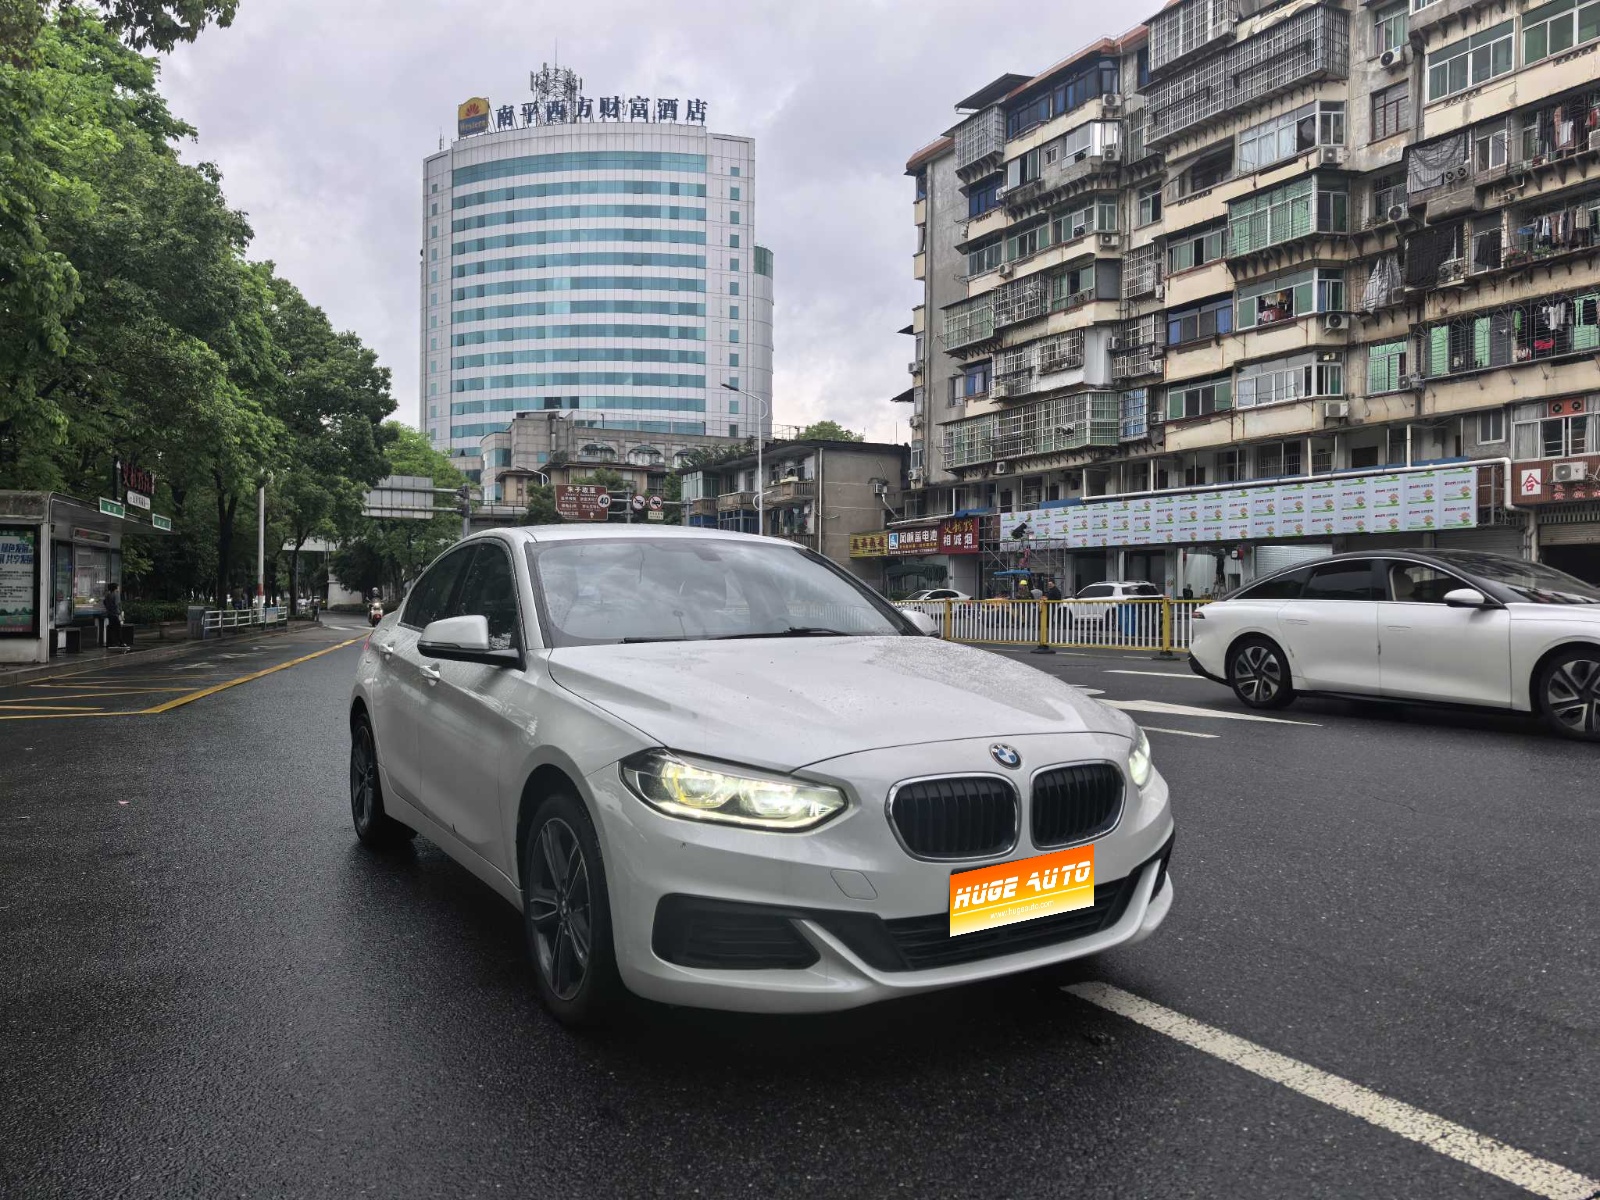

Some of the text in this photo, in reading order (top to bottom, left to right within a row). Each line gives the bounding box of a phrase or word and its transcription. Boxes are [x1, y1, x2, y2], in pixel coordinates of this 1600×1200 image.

[496, 95, 708, 128] 南平西方财富酒店
[1522, 472, 1541, 492] 合
[599, 496, 609, 506] 40
[899, 529, 938, 544] 风帆蓄电池
